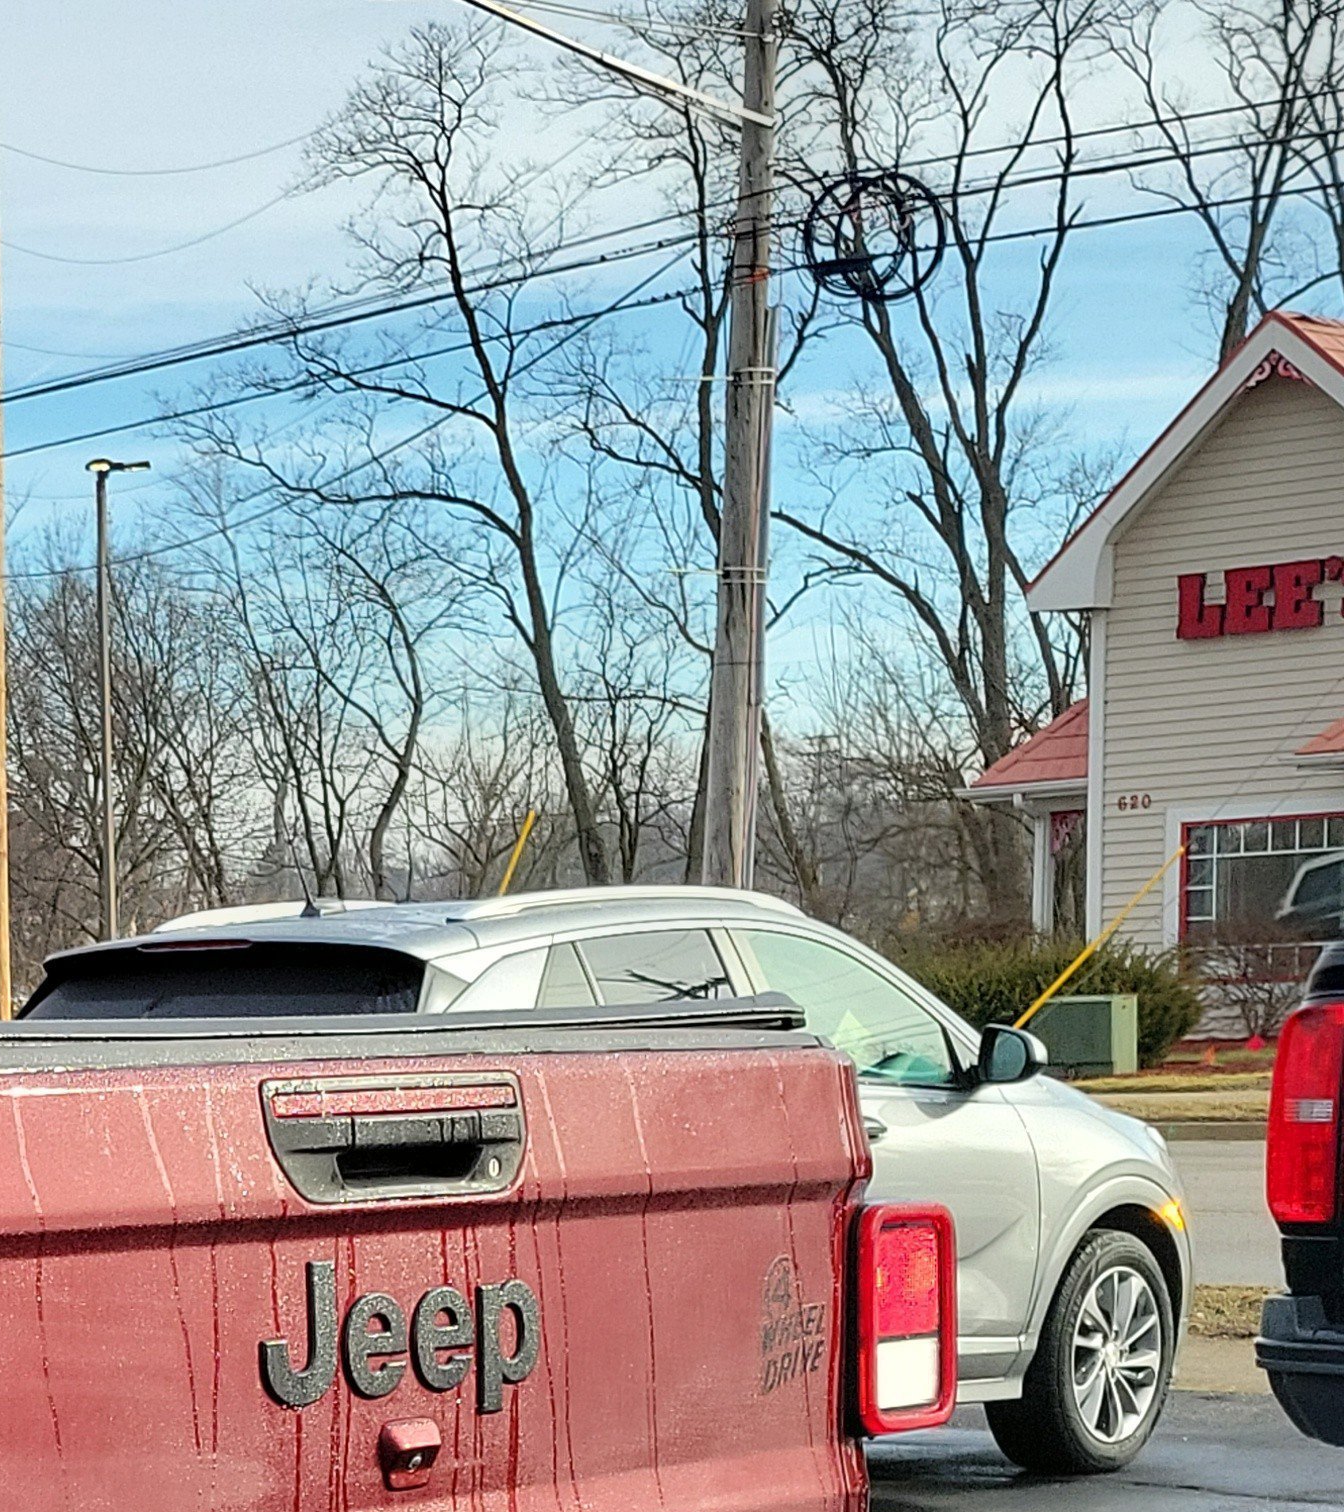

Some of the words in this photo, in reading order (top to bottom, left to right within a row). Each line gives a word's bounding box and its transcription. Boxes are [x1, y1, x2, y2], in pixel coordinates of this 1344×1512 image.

[1177, 555, 1344, 640] LEE'
[1117, 794, 1152, 811] 620
[258, 1259, 541, 1416] Jeep
[763, 1340, 825, 1396] DRIVE
